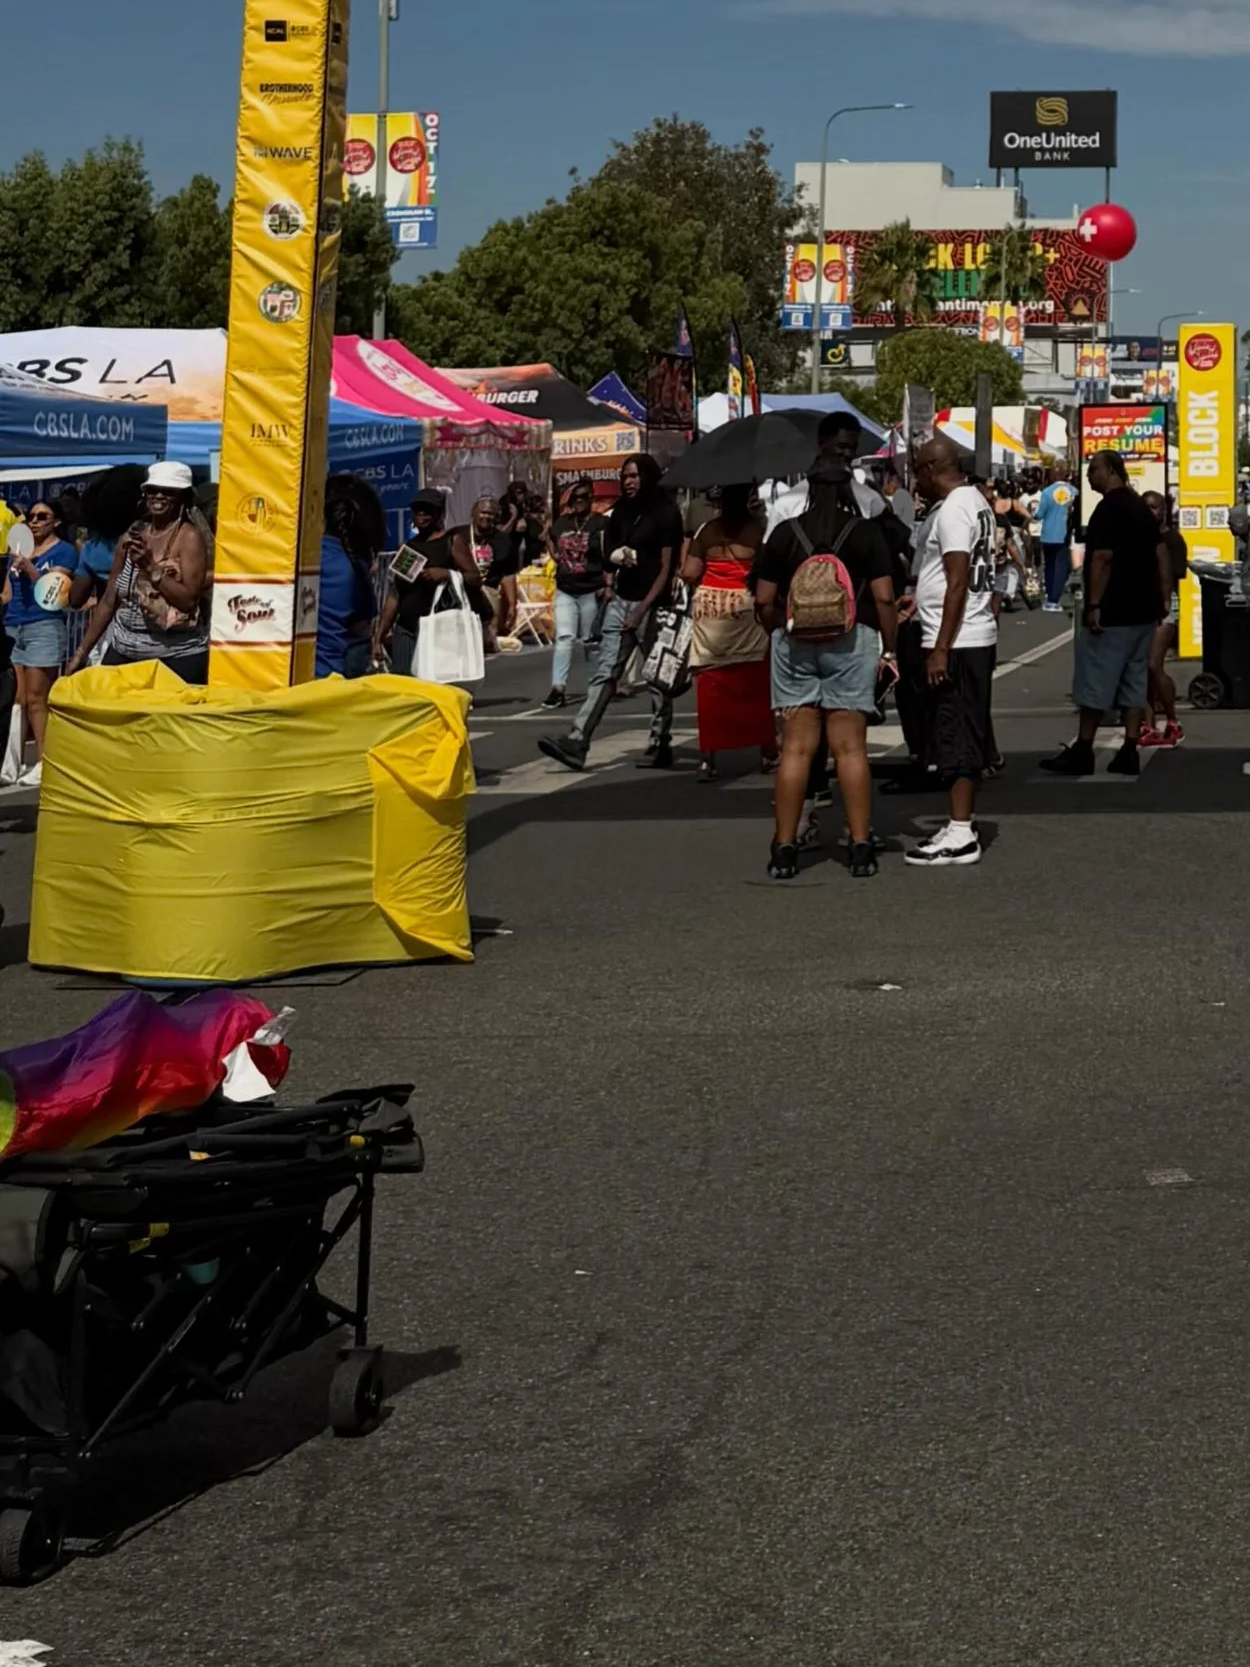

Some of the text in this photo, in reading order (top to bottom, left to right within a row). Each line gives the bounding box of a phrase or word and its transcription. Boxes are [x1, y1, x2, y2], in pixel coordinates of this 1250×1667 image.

[1004, 132, 1101, 150] OneUnited
[269, 146, 313, 159] WAVE
[1034, 151, 1071, 161] BANK
[16, 357, 89, 384] BS
[98, 358, 177, 385] LA
[475, 389, 540, 404] BURGER
[33, 411, 135, 442] CBSLA.COM
[1083, 424, 1163, 436] POST YOUR
[1187, 389, 1220, 477] BLOCK
[552, 435, 609, 455] RINKS
[1083, 438, 1164, 453] RESUME
[390, 462, 415, 479] LA
